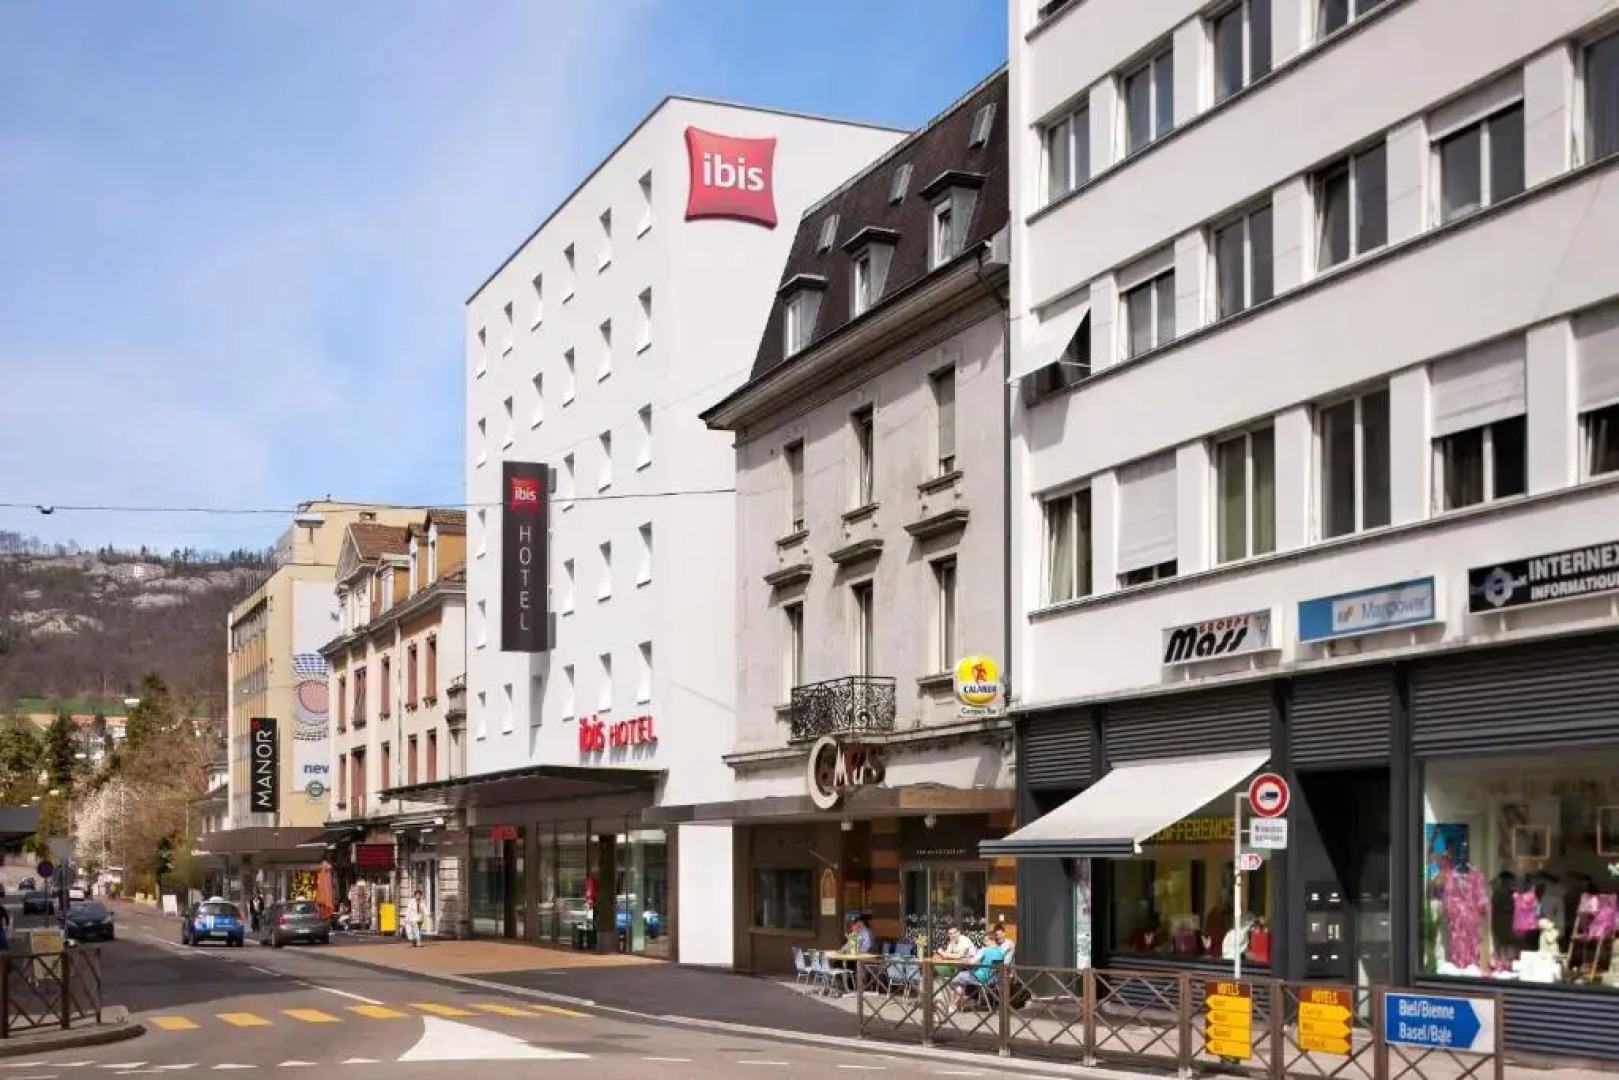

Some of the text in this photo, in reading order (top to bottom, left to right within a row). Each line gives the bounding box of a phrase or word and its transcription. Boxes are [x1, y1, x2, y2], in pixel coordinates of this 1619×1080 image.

[703, 152, 764, 191] ibis
[514, 485, 537, 501] ibis
[519, 524, 532, 631] HOTEL
[1164, 627, 1248, 663] Mass
[579, 715, 658, 752] ibis HOTEL
[256, 730, 272, 807] MANOR
[1399, 999, 1455, 1021] Biel/Bienne
